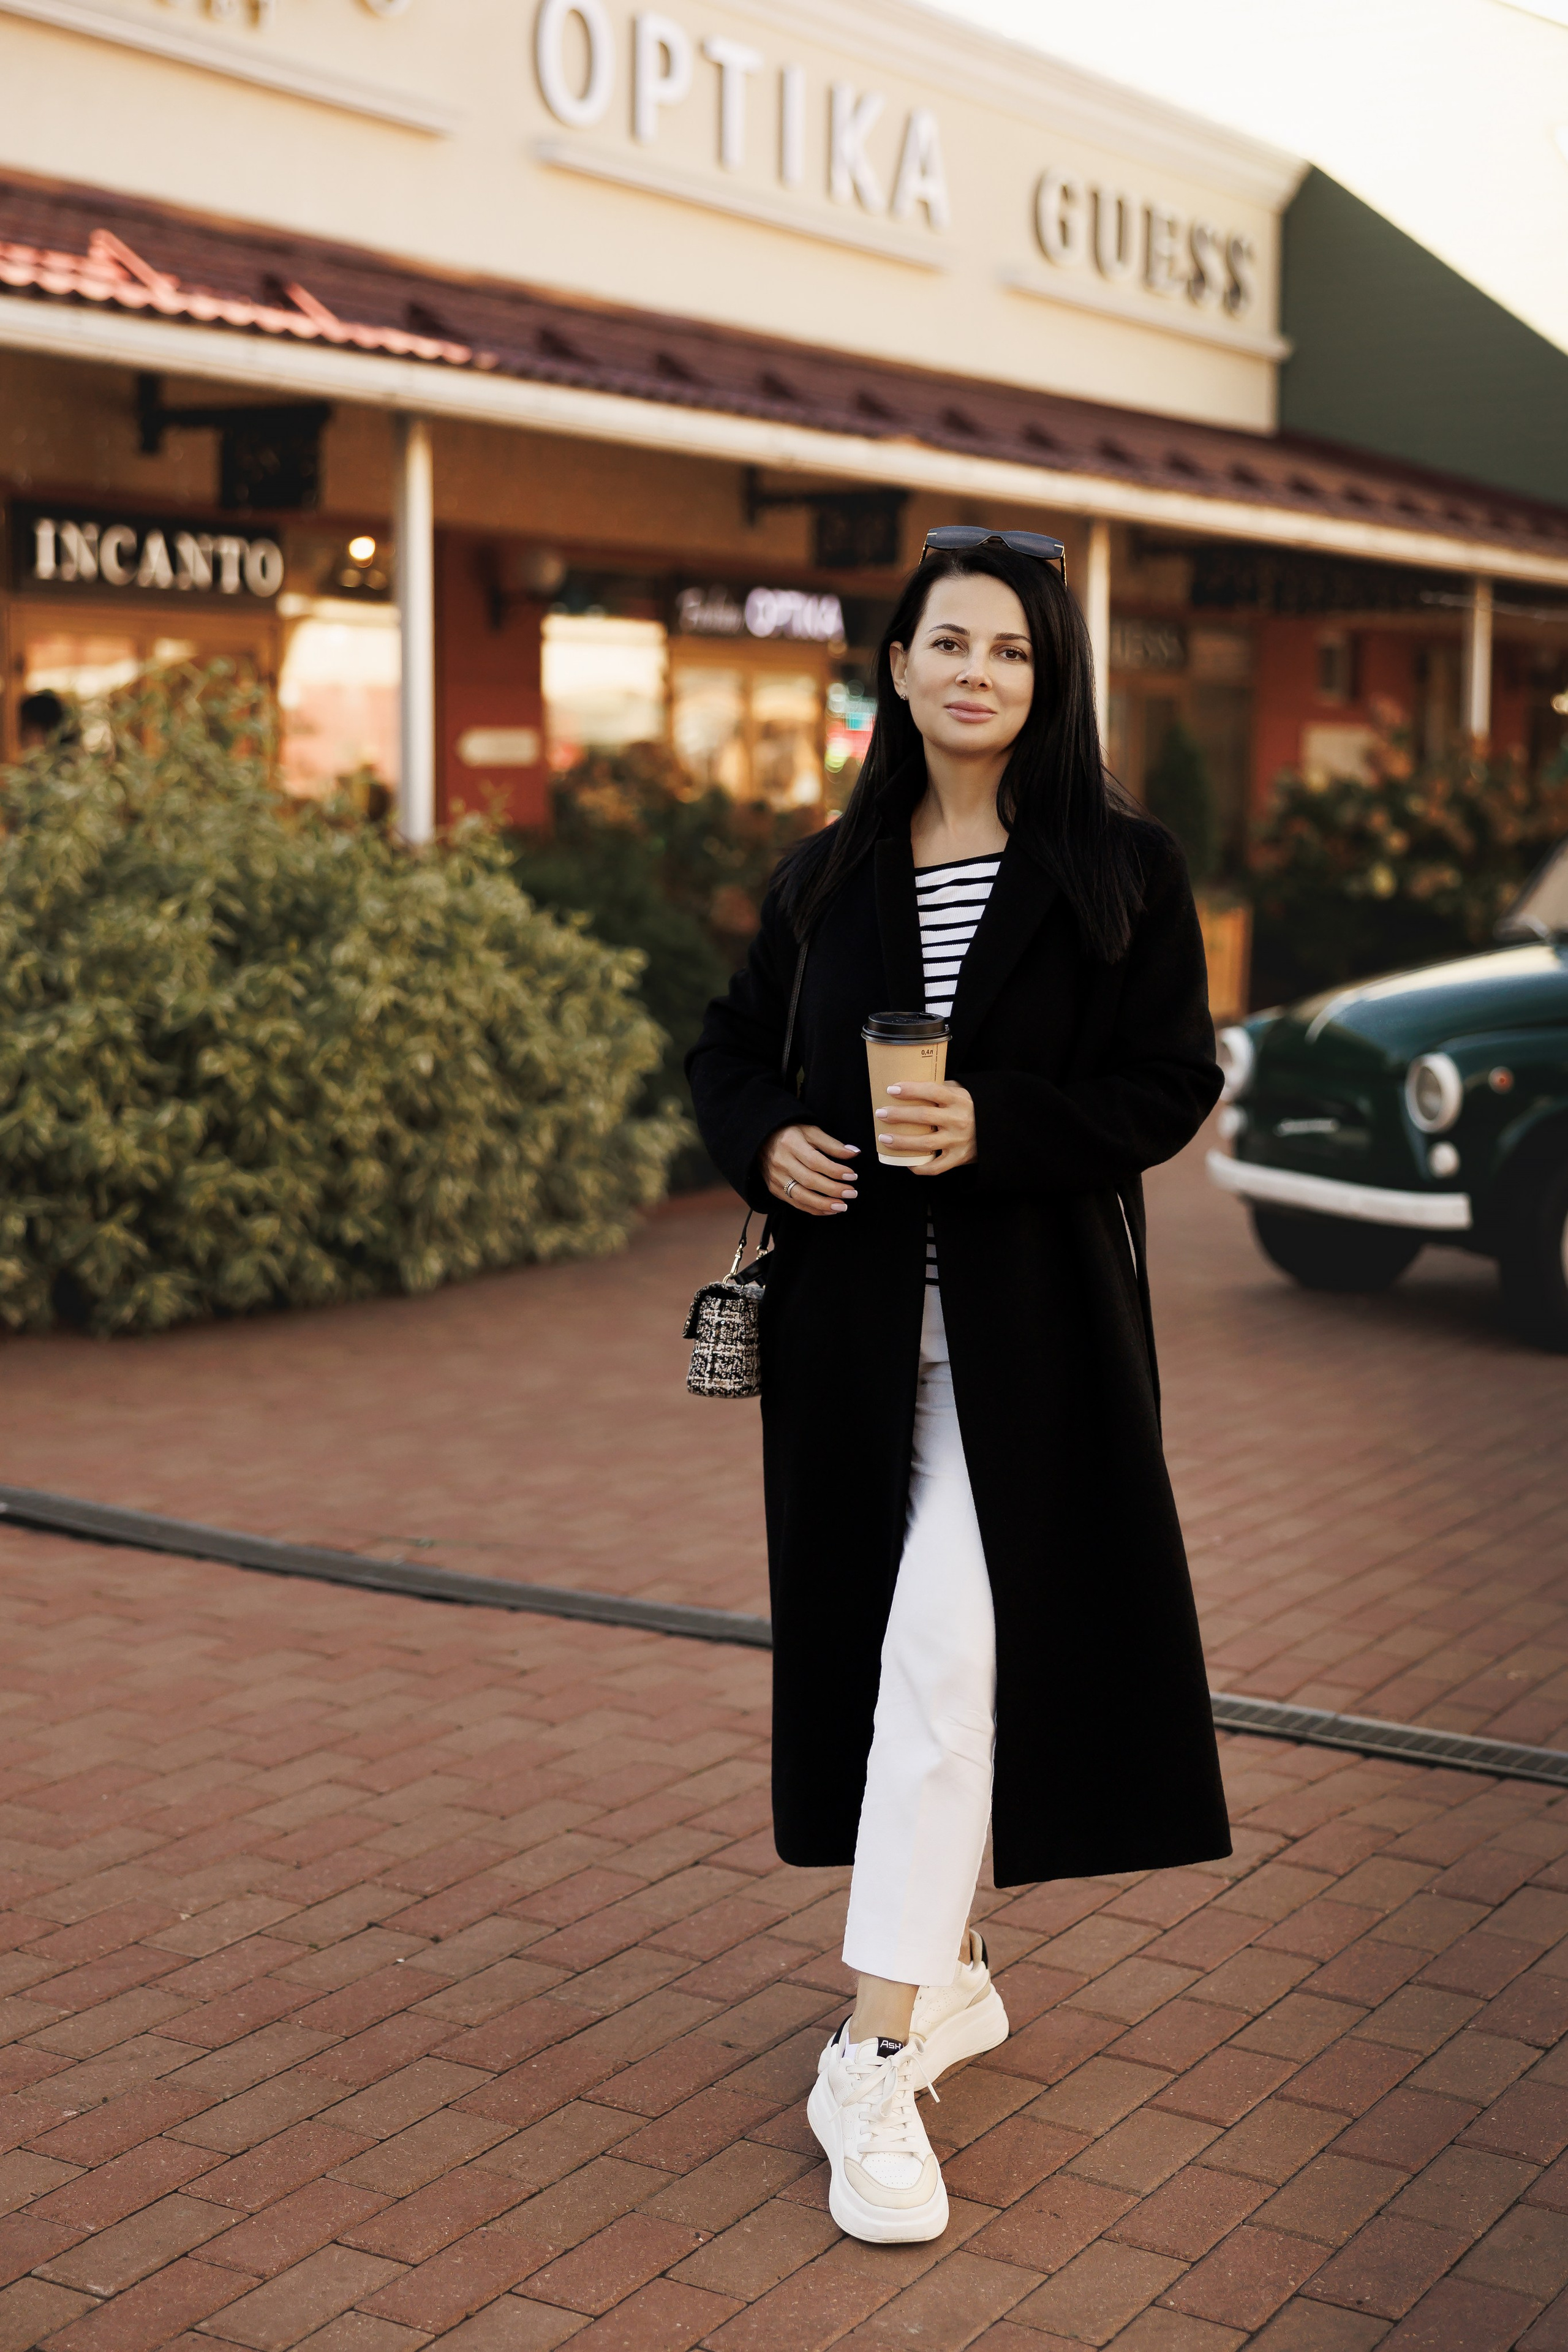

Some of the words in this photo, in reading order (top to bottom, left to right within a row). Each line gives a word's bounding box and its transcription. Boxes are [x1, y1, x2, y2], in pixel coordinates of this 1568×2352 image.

[535, 0, 951, 232] OPTIKA
[1031, 164, 1253, 320] GUESS
[33, 517, 284, 597] INCANTO
[880, 2040, 902, 2050] ASH
